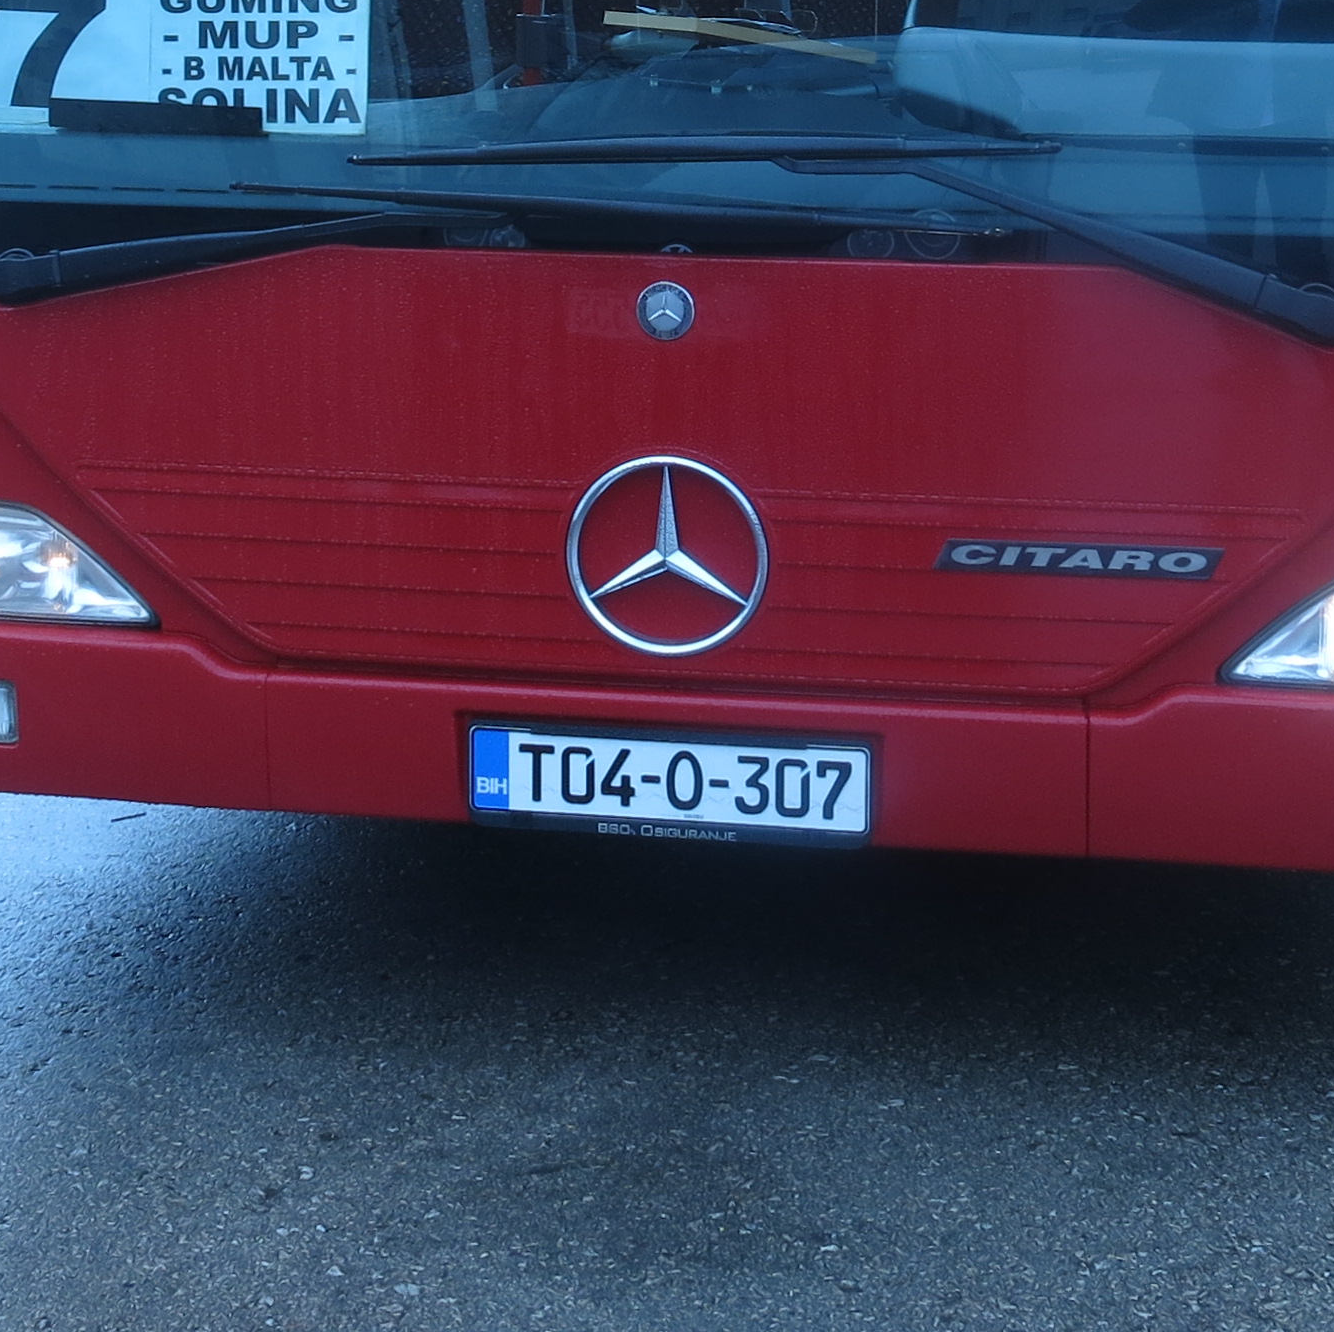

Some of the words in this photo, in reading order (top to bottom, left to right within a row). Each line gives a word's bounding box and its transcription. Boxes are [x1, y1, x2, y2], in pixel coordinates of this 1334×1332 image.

[198, 20, 319, 50] MUP
[184, 56, 205, 80] B
[217, 56, 335, 81] MALTA
[950, 544, 1208, 573] CITARO
[476, 776, 508, 796] BIH
